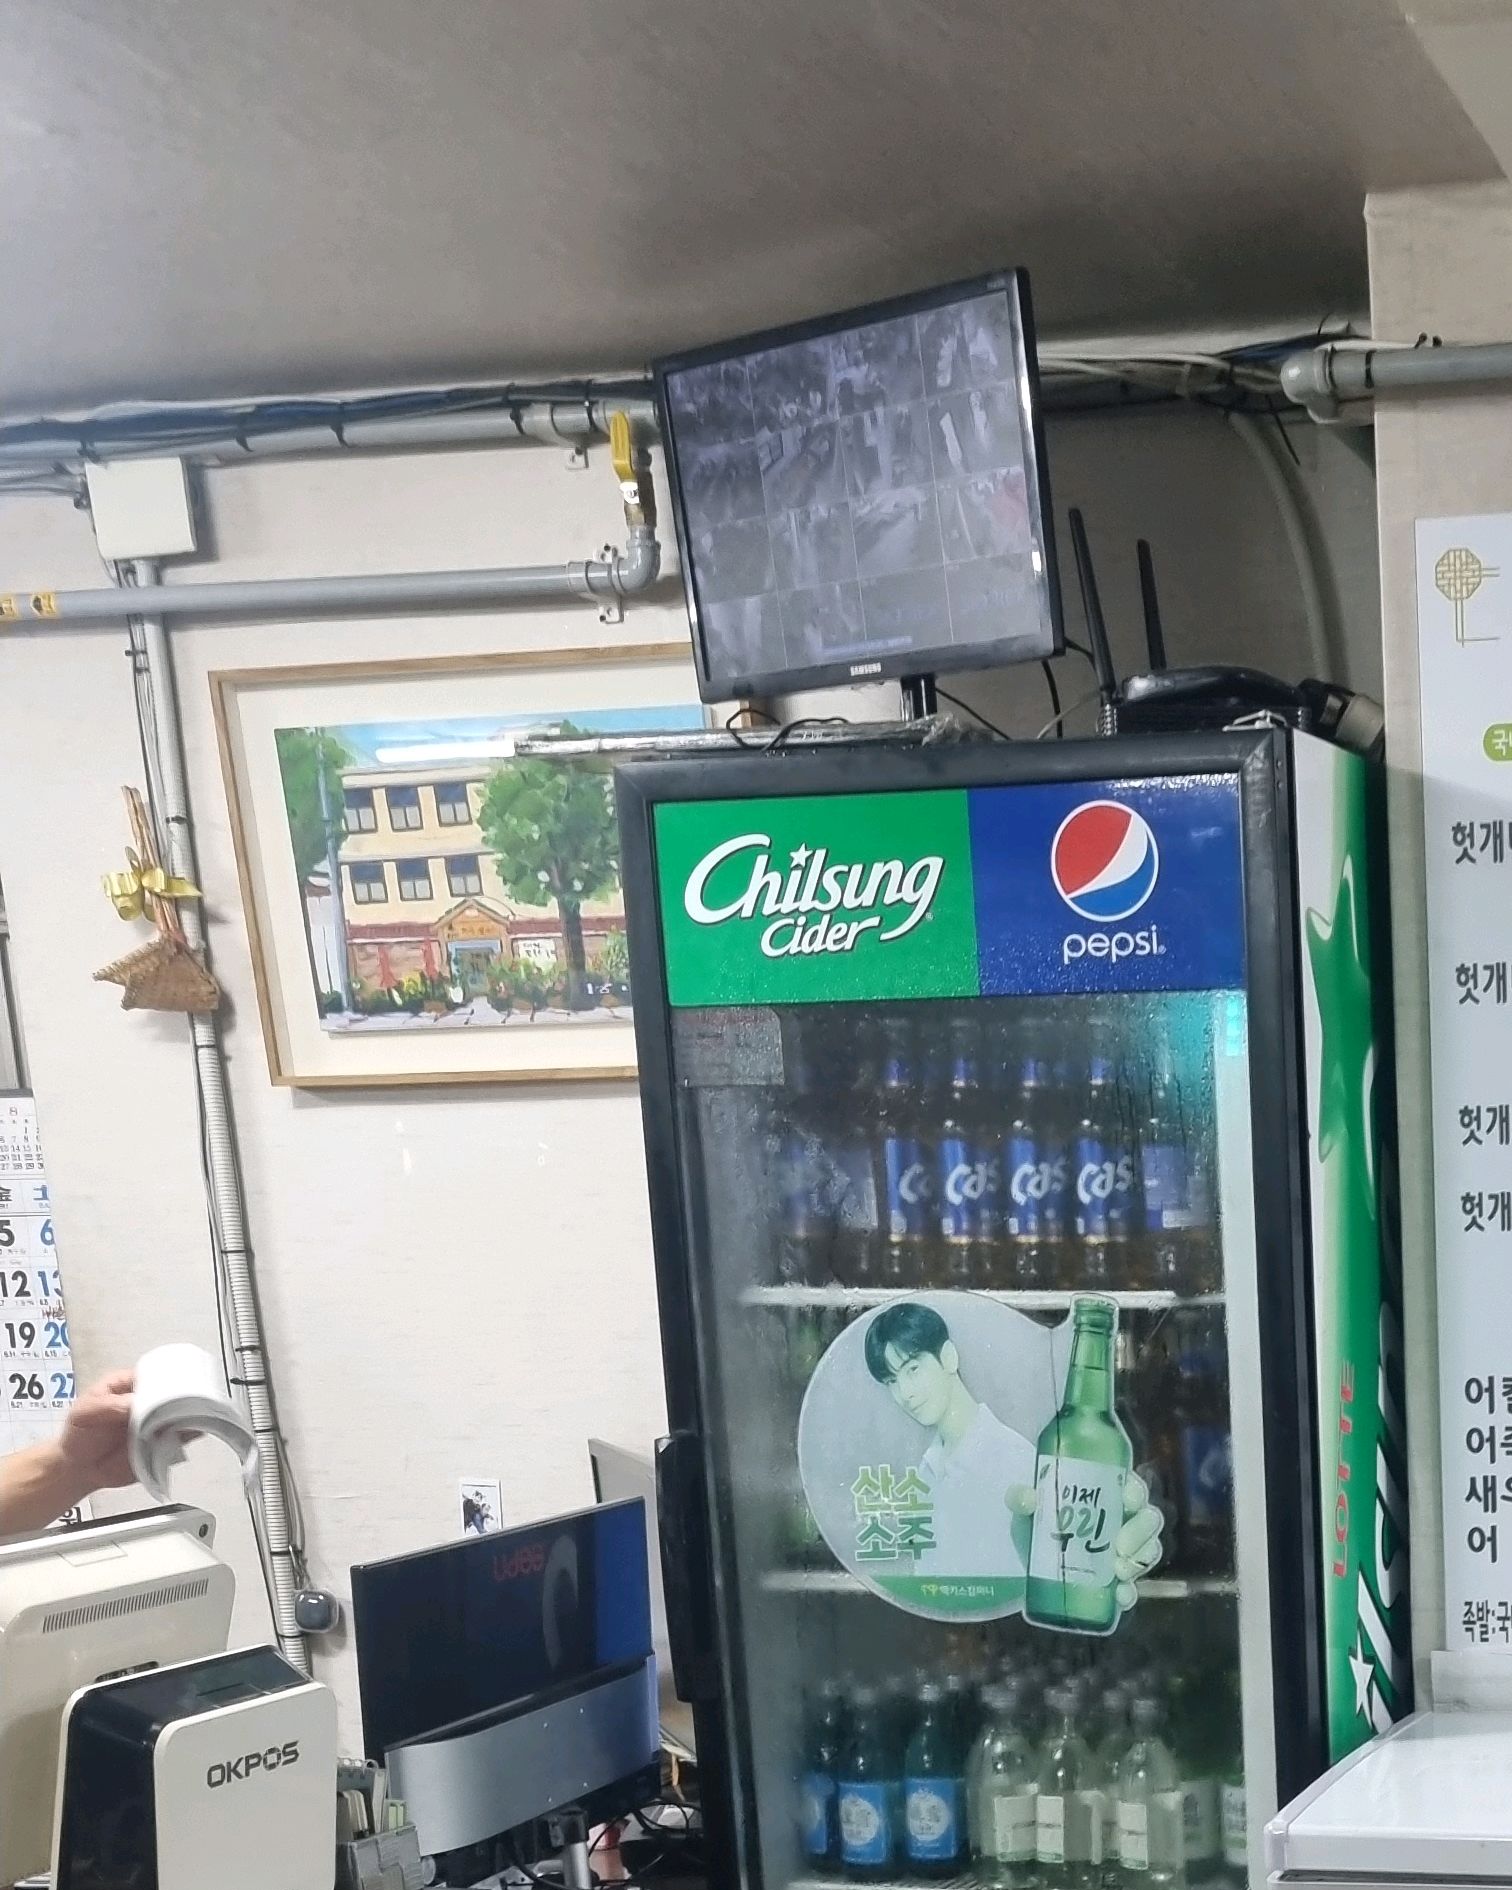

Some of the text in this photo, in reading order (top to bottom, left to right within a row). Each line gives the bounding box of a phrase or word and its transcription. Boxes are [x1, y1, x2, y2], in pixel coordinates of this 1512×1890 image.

[684, 833, 944, 941] Chilsung
[760, 915, 880, 957] Cider
[1063, 925, 1158, 964] pepsi
[5, 1322, 36, 1348] 19
[9, 1373, 45, 1400] 26
[852, 1464, 934, 1514] 산소
[1333, 1359, 1355, 1578] LOTTE
[1061, 1485, 1102, 1505] 이제
[855, 1516, 937, 1561] 소주
[206, 1740, 300, 1789] OKPOS
